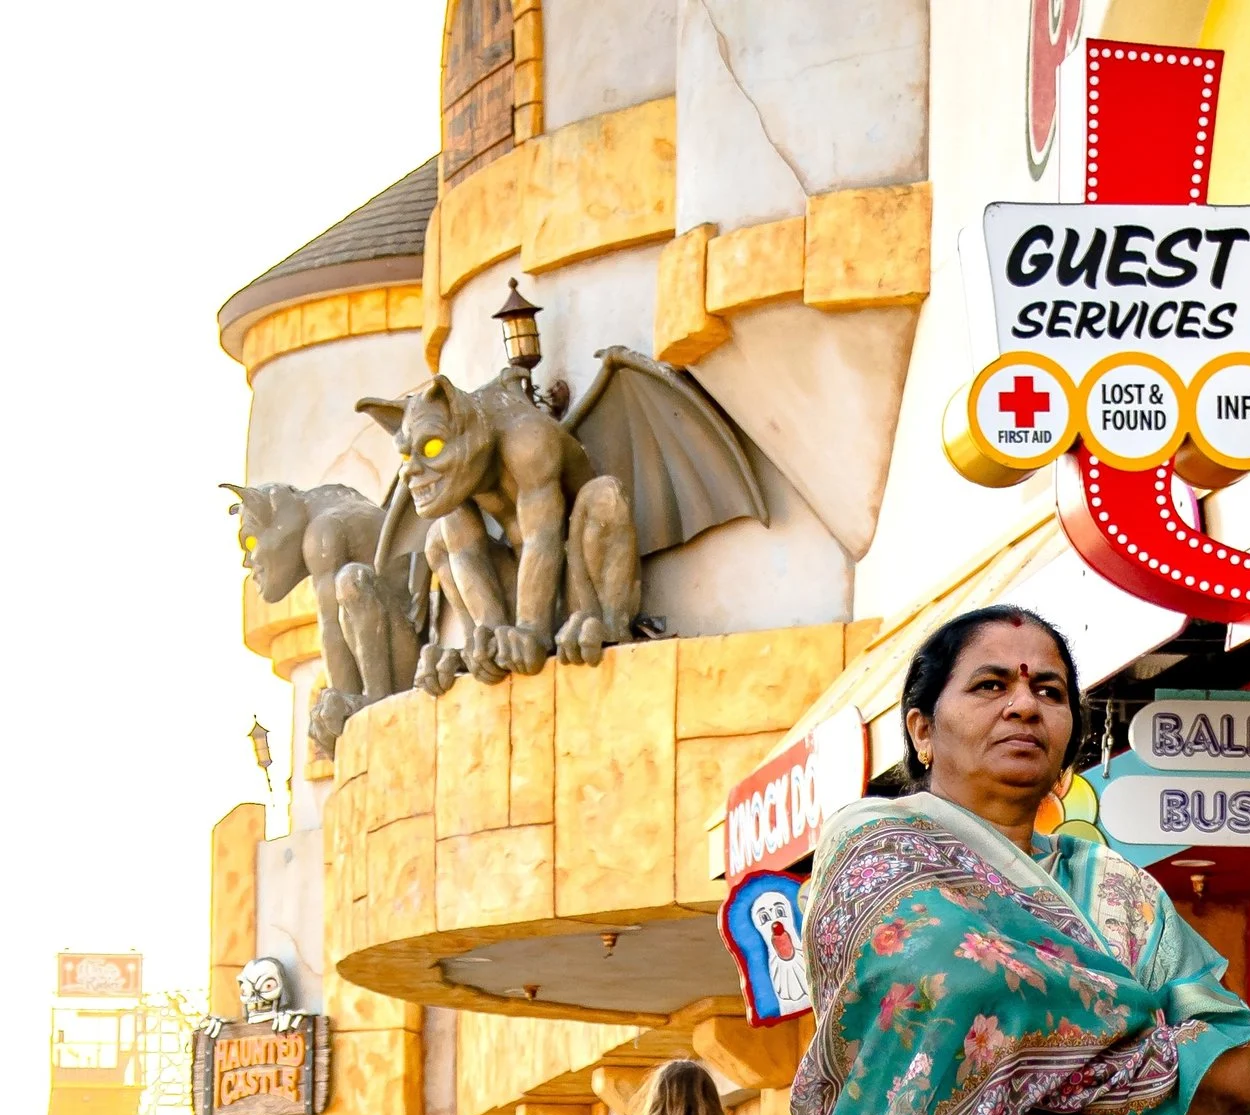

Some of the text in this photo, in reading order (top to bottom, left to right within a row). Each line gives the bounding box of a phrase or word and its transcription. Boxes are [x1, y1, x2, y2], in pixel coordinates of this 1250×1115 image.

[1005, 224, 1250, 290] GUEST
[1011, 300, 1238, 339] SERVICES
[1101, 383, 1164, 405] LOST &
[998, 430, 1052, 444] FIRST AID
[1102, 410, 1167, 431] FOUND
[729, 772, 790, 878] KNOCK
[214, 1032, 305, 1108] HAUNTED
[220, 1066, 299, 1105] CASTLE
